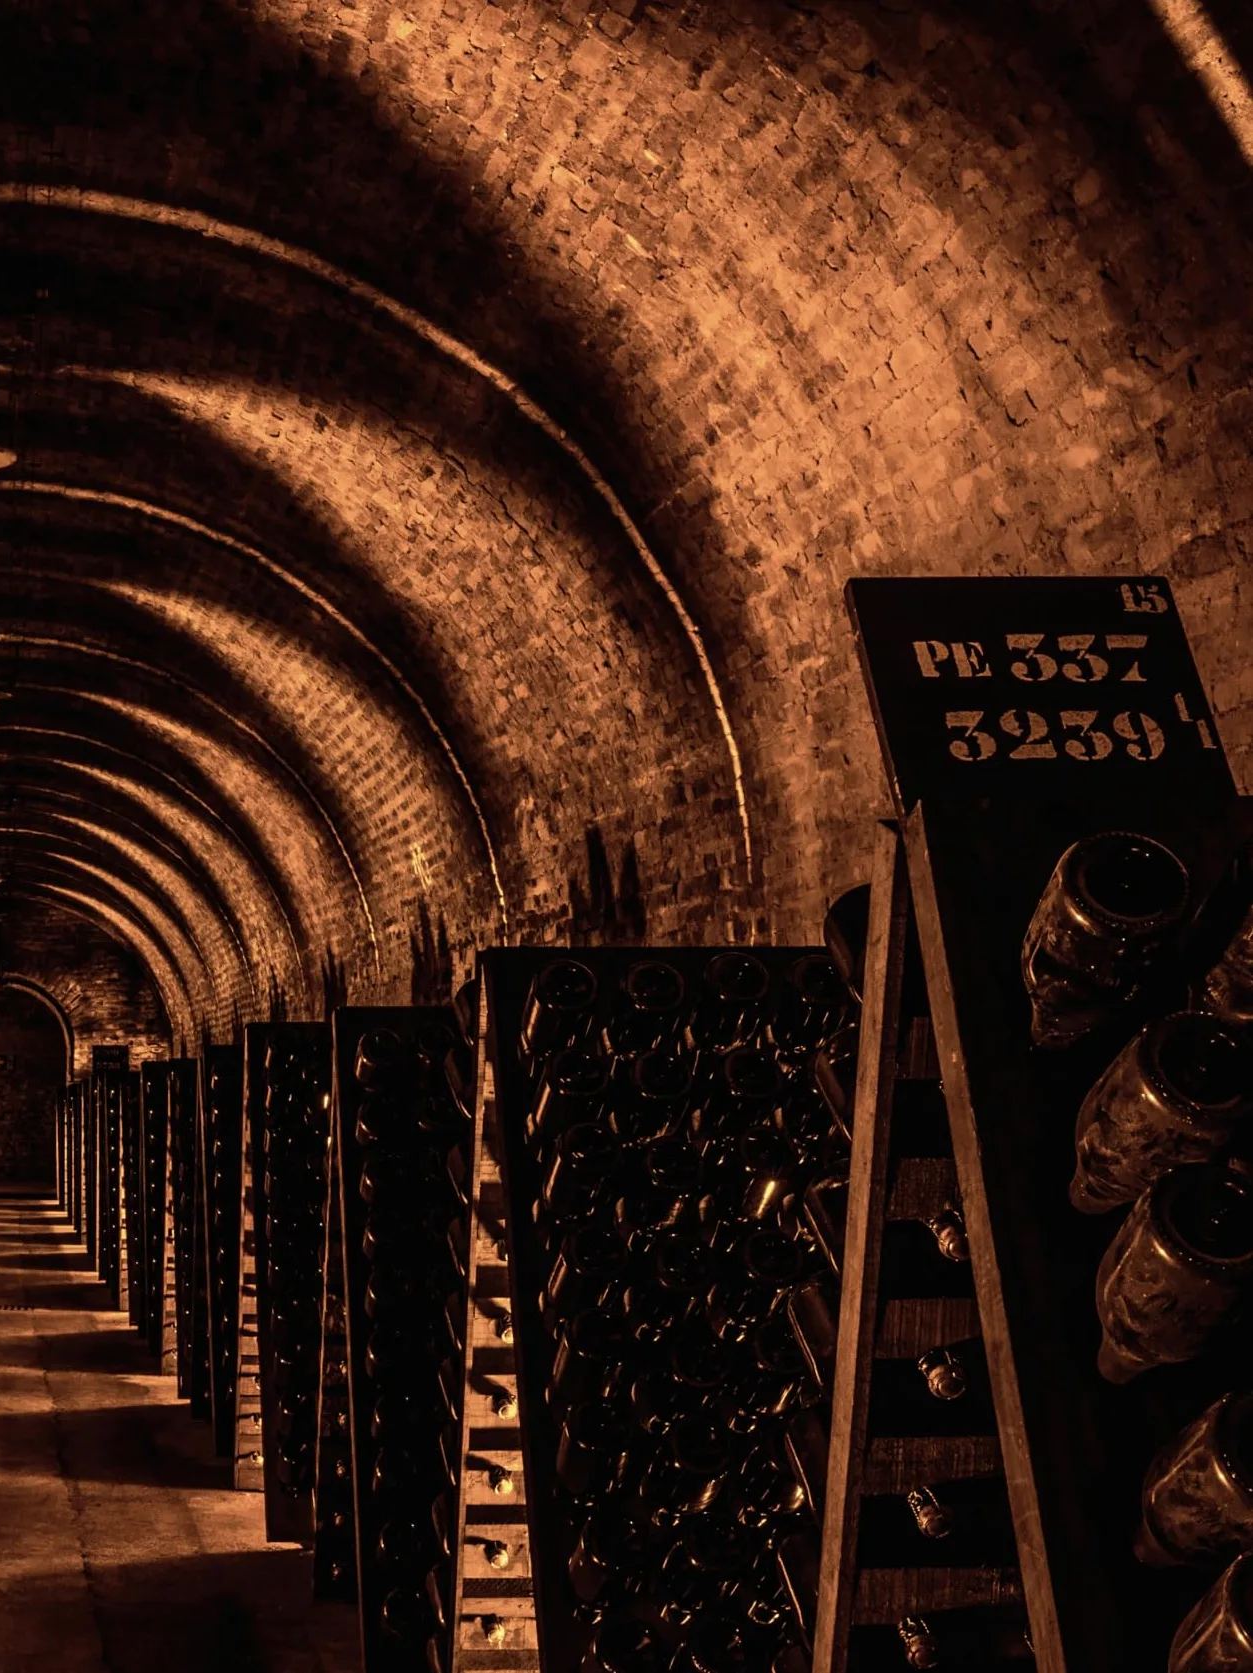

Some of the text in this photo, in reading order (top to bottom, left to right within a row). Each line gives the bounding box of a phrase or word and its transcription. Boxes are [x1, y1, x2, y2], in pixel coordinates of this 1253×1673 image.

[912, 632, 1150, 682] PE 337
[944, 709, 1167, 762] 3239
